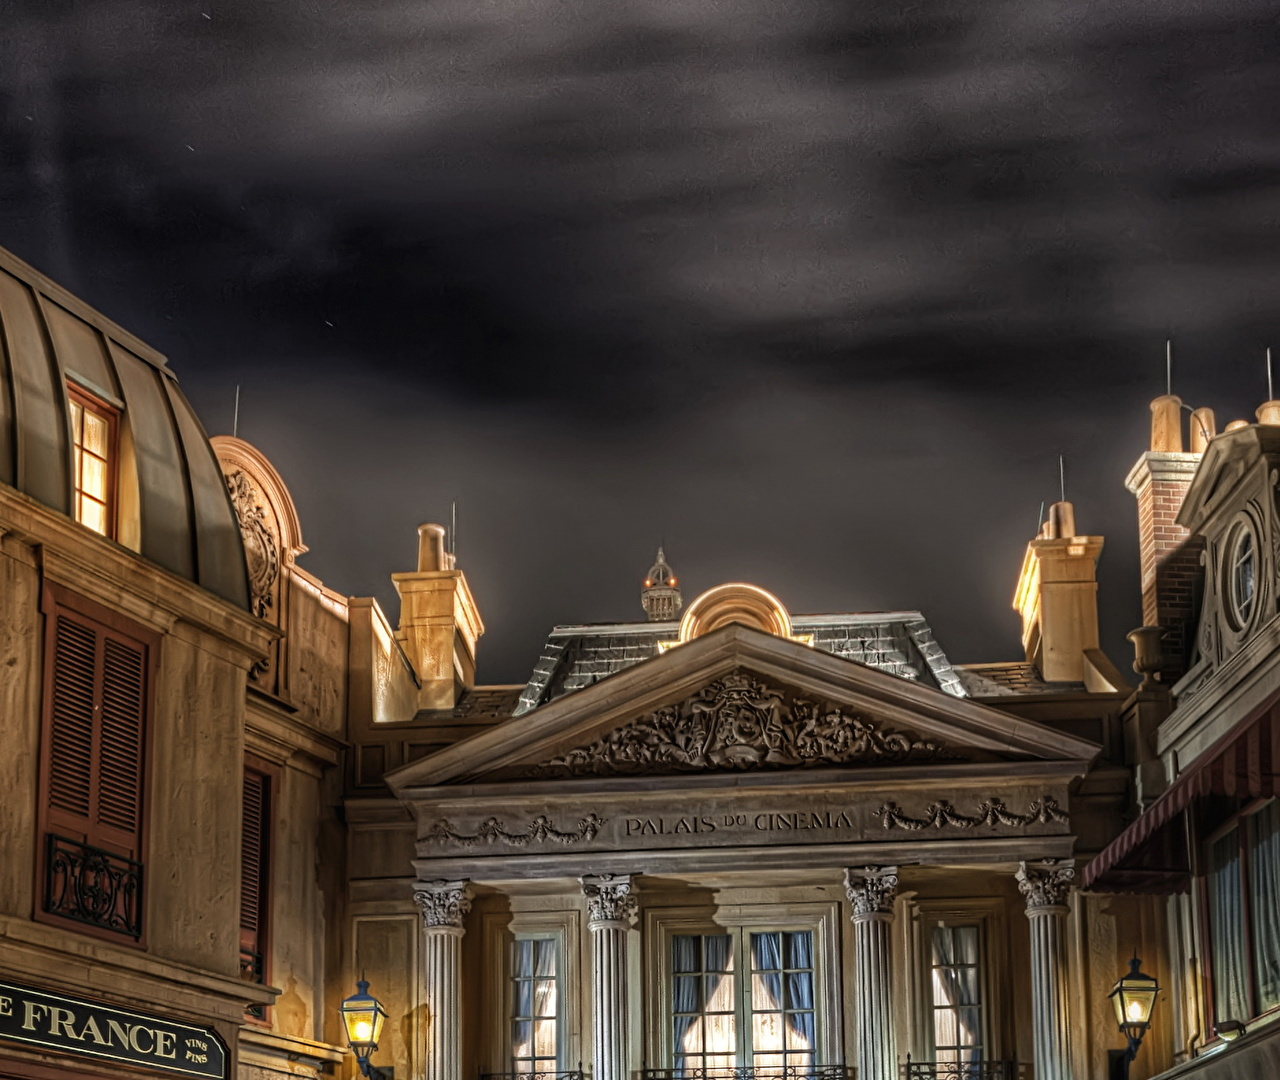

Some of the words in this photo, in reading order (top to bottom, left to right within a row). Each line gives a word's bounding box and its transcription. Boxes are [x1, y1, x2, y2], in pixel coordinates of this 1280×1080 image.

[625, 815, 717, 836] PALAIS
[724, 814, 747, 827] DU
[754, 811, 853, 832] CINEMA
[21, 1000, 177, 1060] FRANCE
[184, 1038, 208, 1052] VINS
